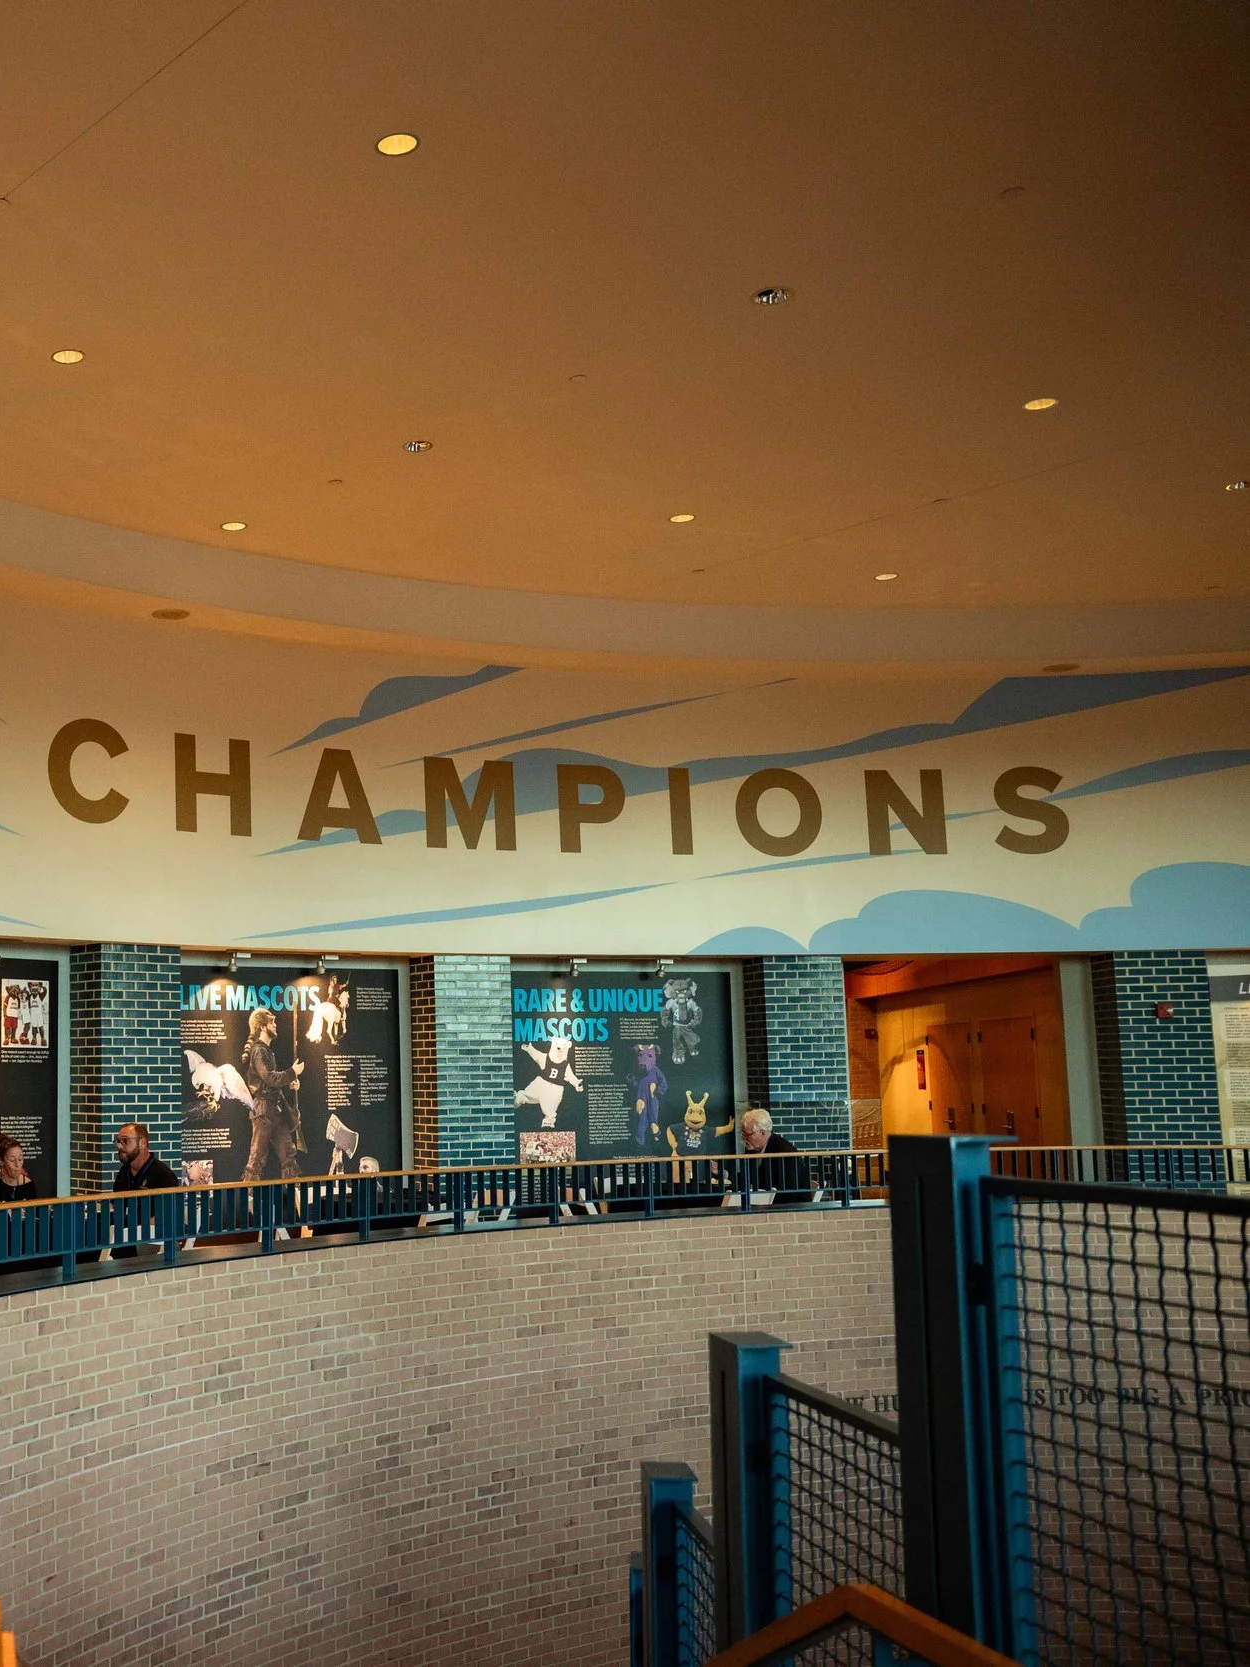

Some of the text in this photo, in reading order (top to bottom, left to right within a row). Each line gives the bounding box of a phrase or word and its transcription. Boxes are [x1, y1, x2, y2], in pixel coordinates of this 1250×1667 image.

[47, 717, 1070, 857] CHAMPIONS
[180, 984, 321, 1012] LIVE MASCOTS
[514, 988, 664, 1013] RARE & UNIQUE
[514, 1017, 609, 1042] MASCOTS
[1054, 1387, 1105, 1405] TOO
